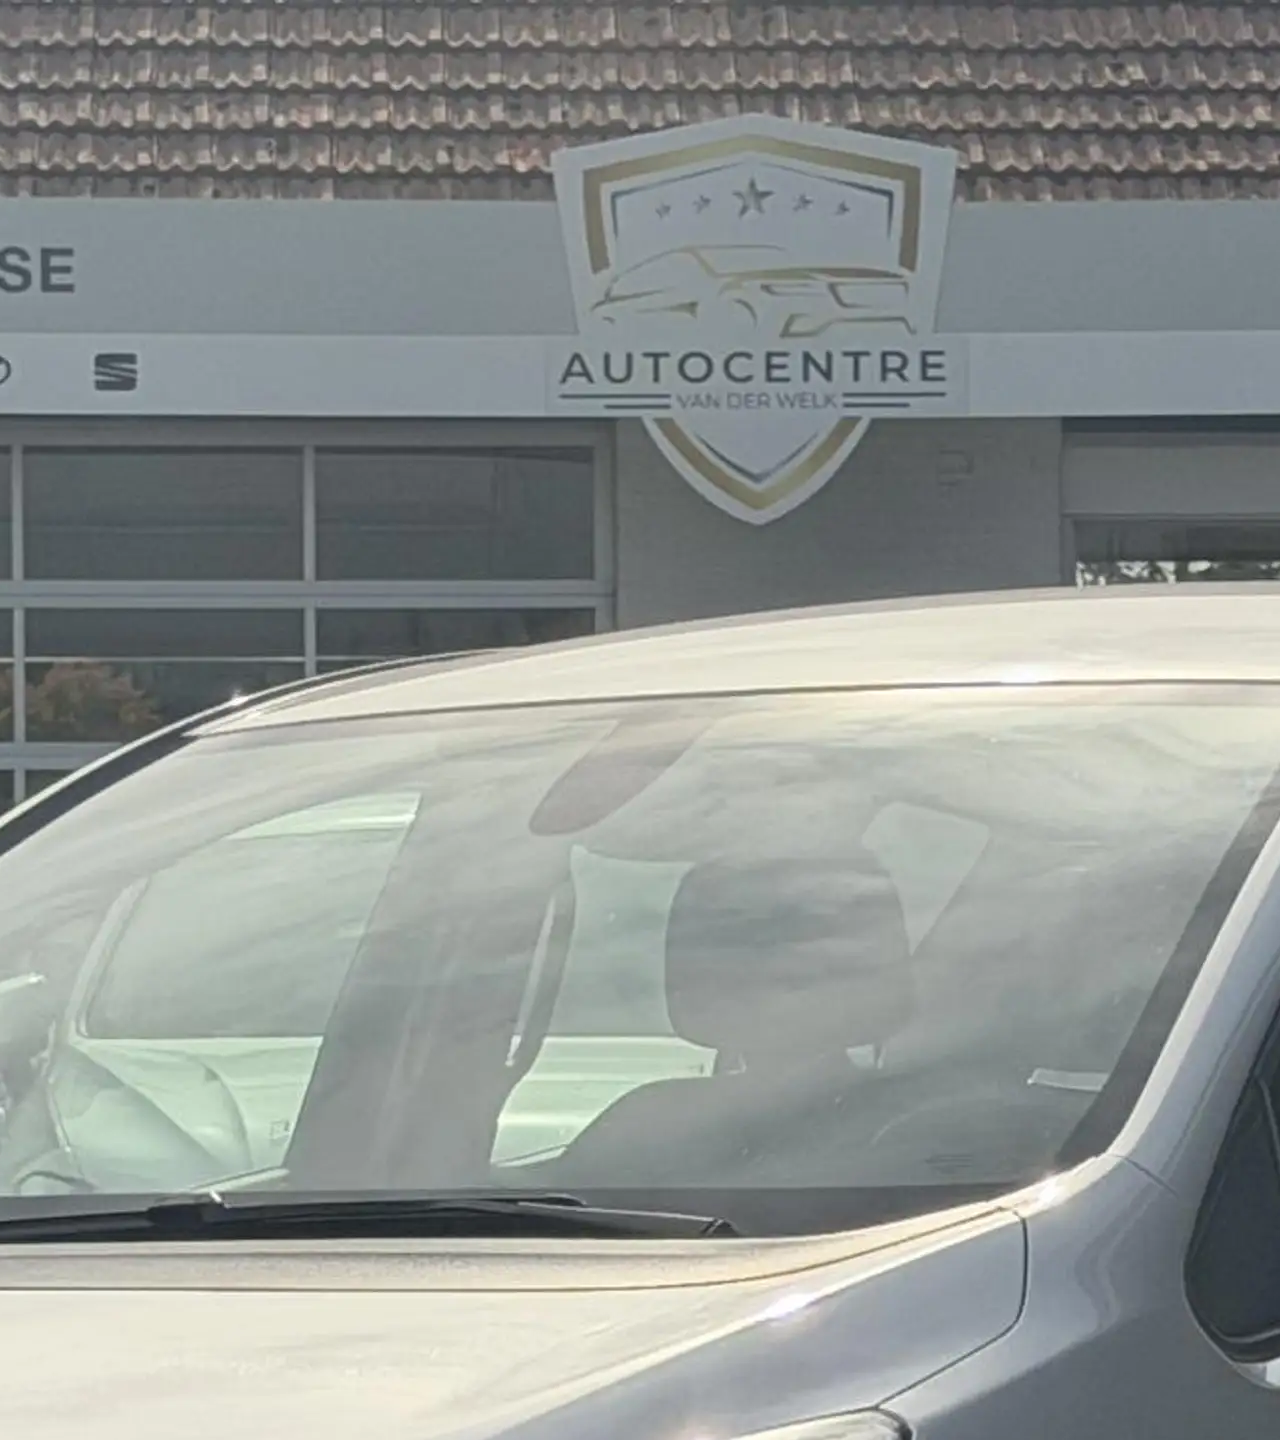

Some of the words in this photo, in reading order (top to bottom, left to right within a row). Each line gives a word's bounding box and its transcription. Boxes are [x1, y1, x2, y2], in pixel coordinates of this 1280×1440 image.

[559, 350, 947, 385] AUTOCENTRE
[677, 392, 720, 410] VAN
[726, 391, 771, 410] DER
